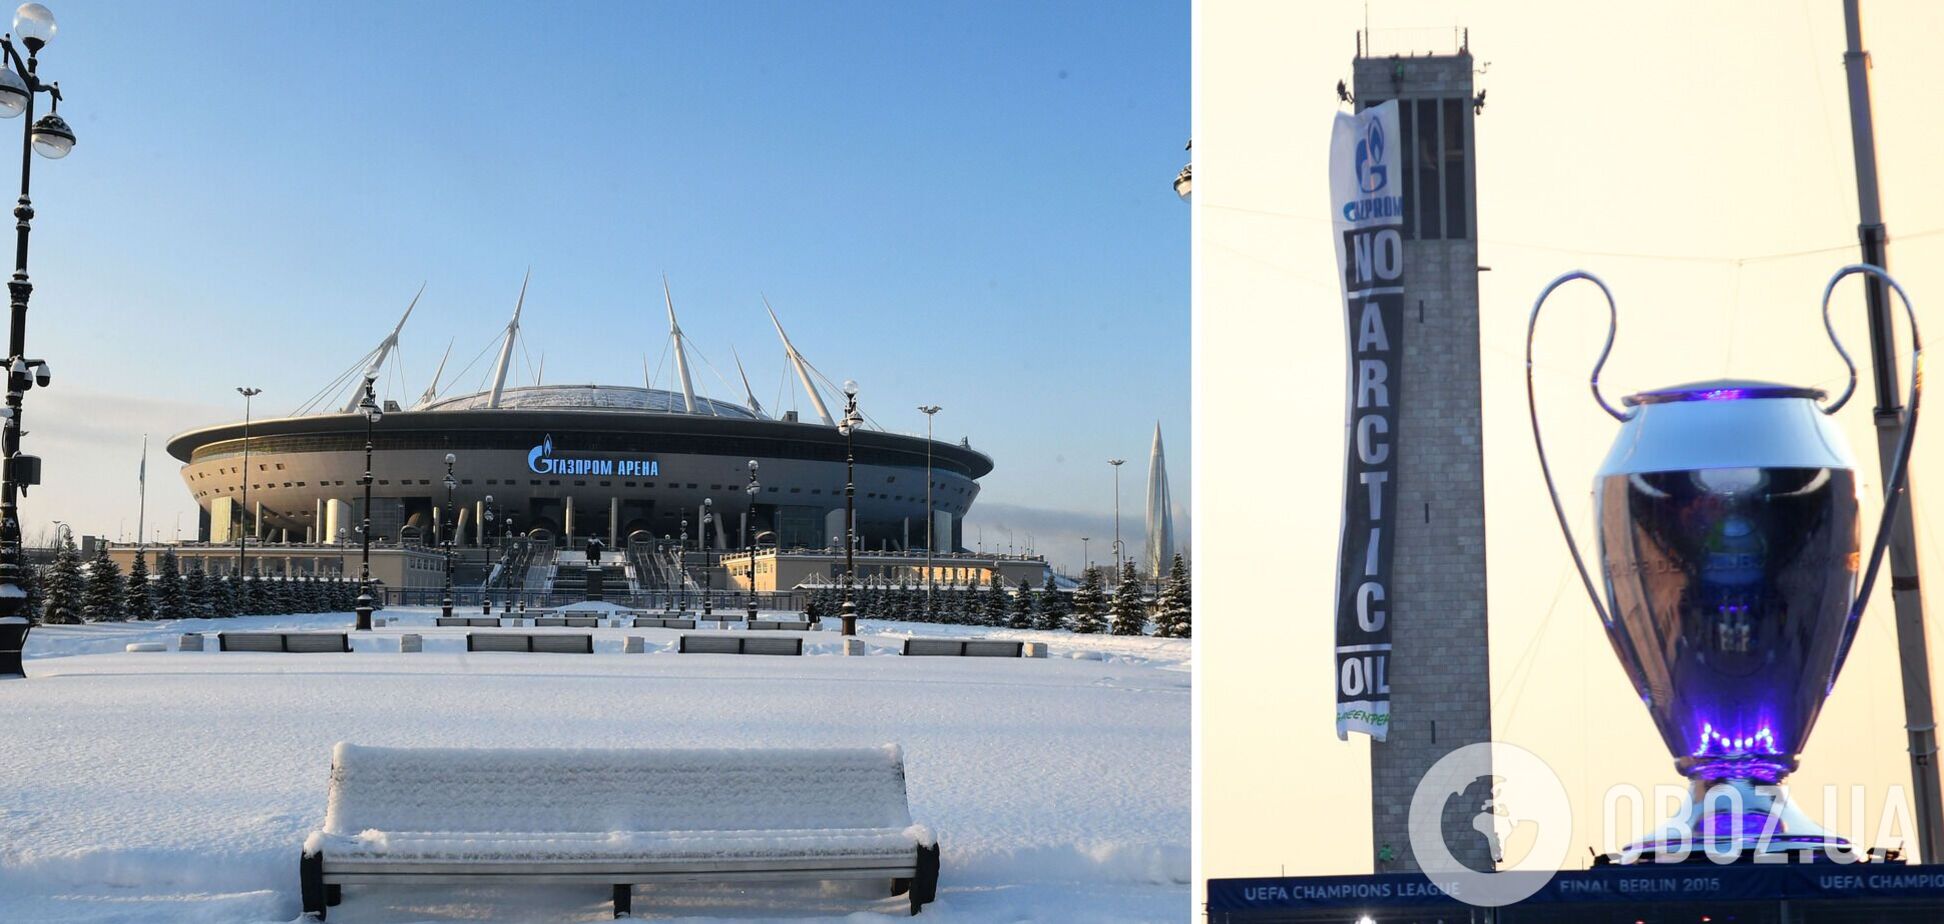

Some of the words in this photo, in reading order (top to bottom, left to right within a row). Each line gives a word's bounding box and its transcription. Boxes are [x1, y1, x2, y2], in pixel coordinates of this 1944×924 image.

[1354, 228, 1403, 284] NO
[552, 458, 613, 476] ГАЗПРОМ
[617, 460, 659, 476] АРЕНА
[1356, 301, 1390, 633] ARCTIC
[1340, 655, 1391, 697] OIL
[1244, 886, 1289, 901] UEFA
[1292, 883, 1392, 900] CHAMPIONS
[1396, 881, 1461, 897] LEAGUE
[1559, 879, 1609, 894] FINAL
[1619, 878, 1677, 893] BERLIN
[1682, 877, 1721, 892] 2015
[1820, 875, 1866, 889] UEFA
